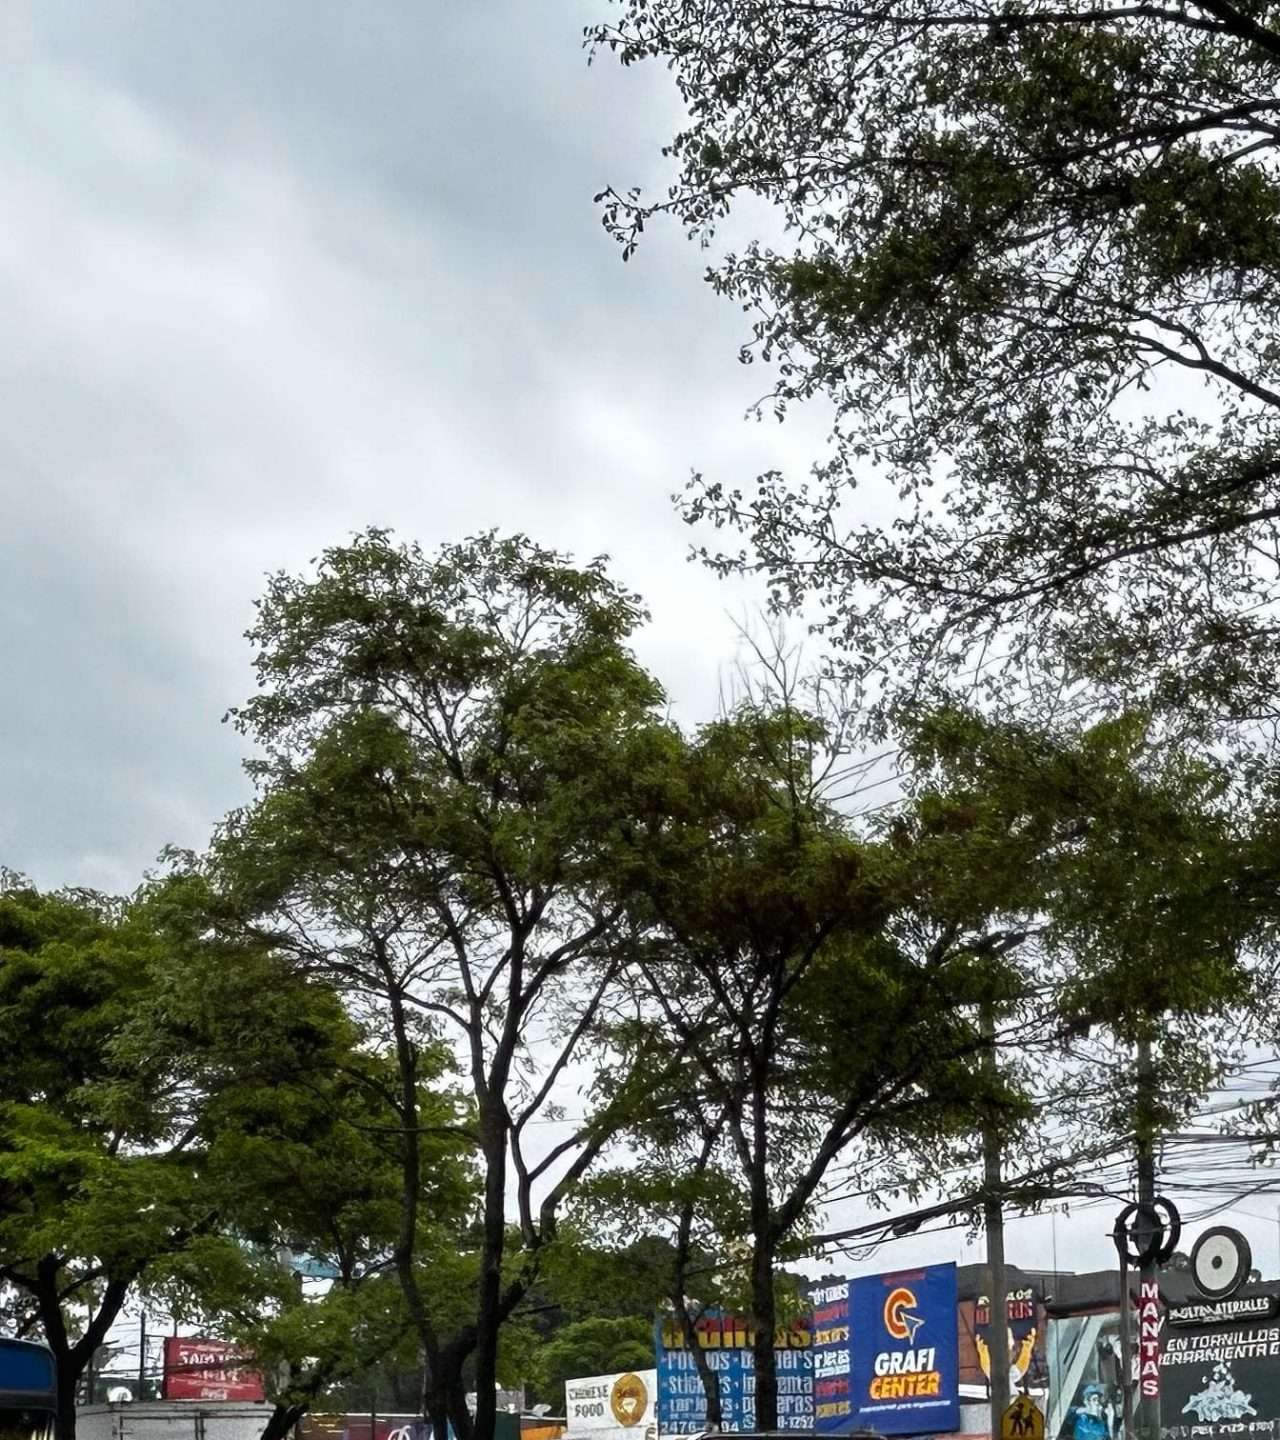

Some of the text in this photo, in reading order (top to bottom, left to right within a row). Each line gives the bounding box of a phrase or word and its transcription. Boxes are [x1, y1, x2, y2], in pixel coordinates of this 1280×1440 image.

[1141, 1283, 1159, 1396] MANTAS
[874, 1348, 936, 1376] GRAFI
[870, 1372, 941, 1399] CENTER
